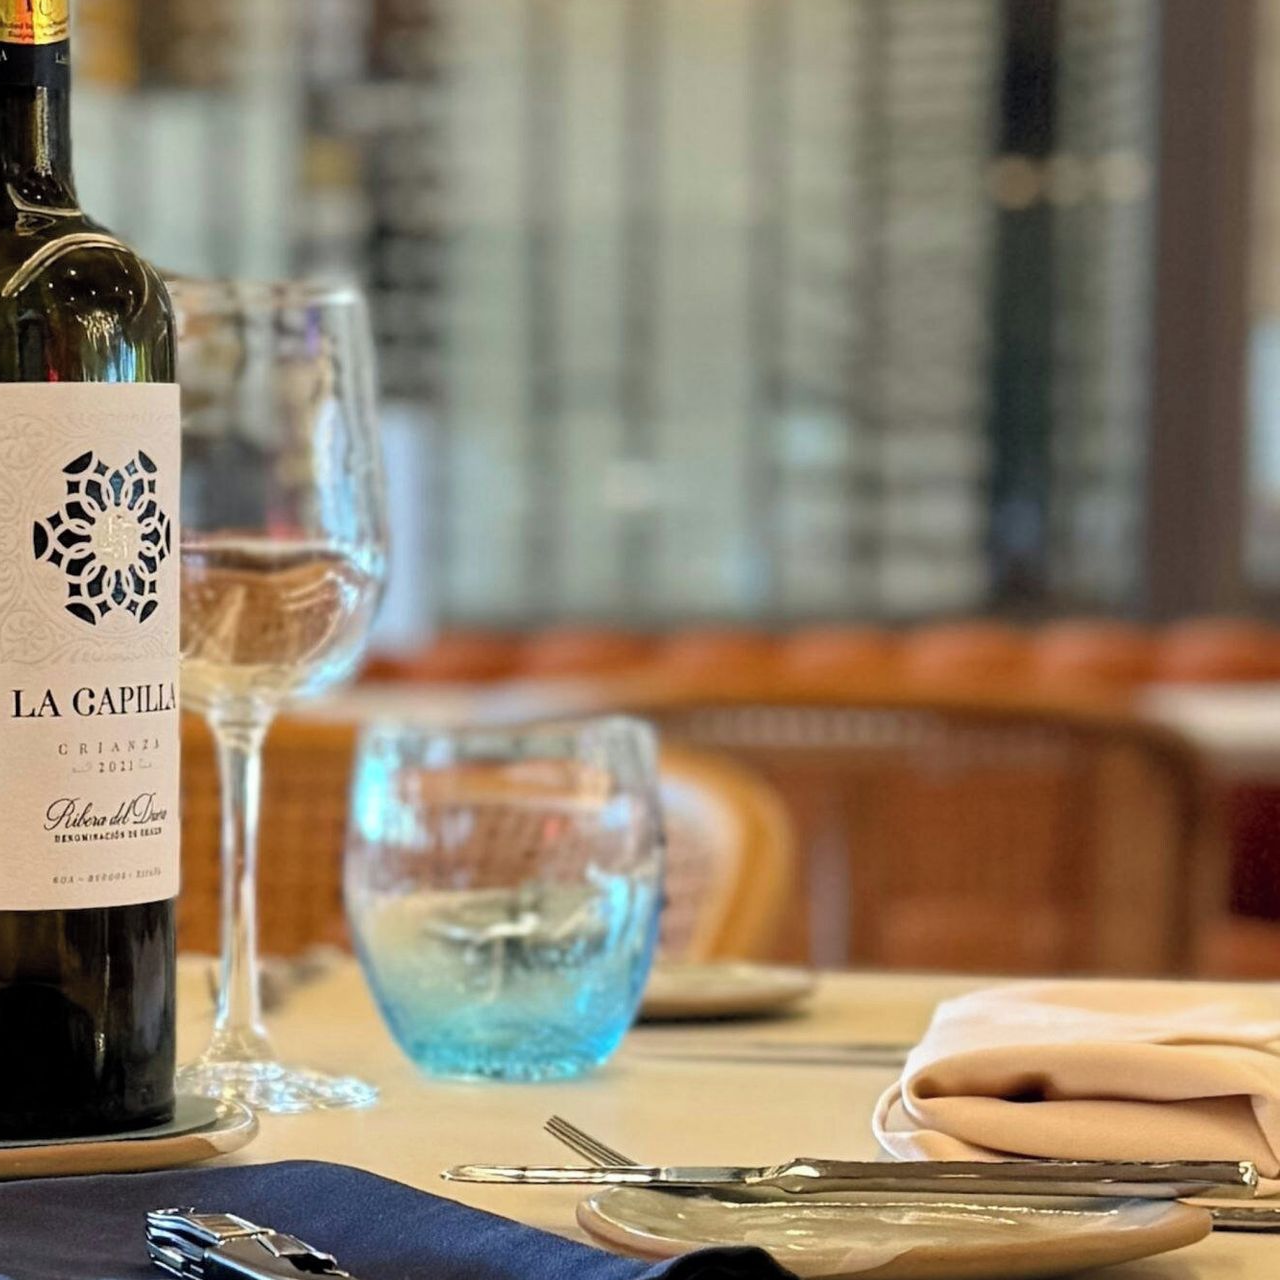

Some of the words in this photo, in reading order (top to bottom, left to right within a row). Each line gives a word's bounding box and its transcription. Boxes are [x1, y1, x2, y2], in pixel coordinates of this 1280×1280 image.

[11, 688, 62, 718] LA
[72, 682, 176, 718] CAPILLA
[98, 759, 134, 774] 2021
[109, 799, 135, 826] del
